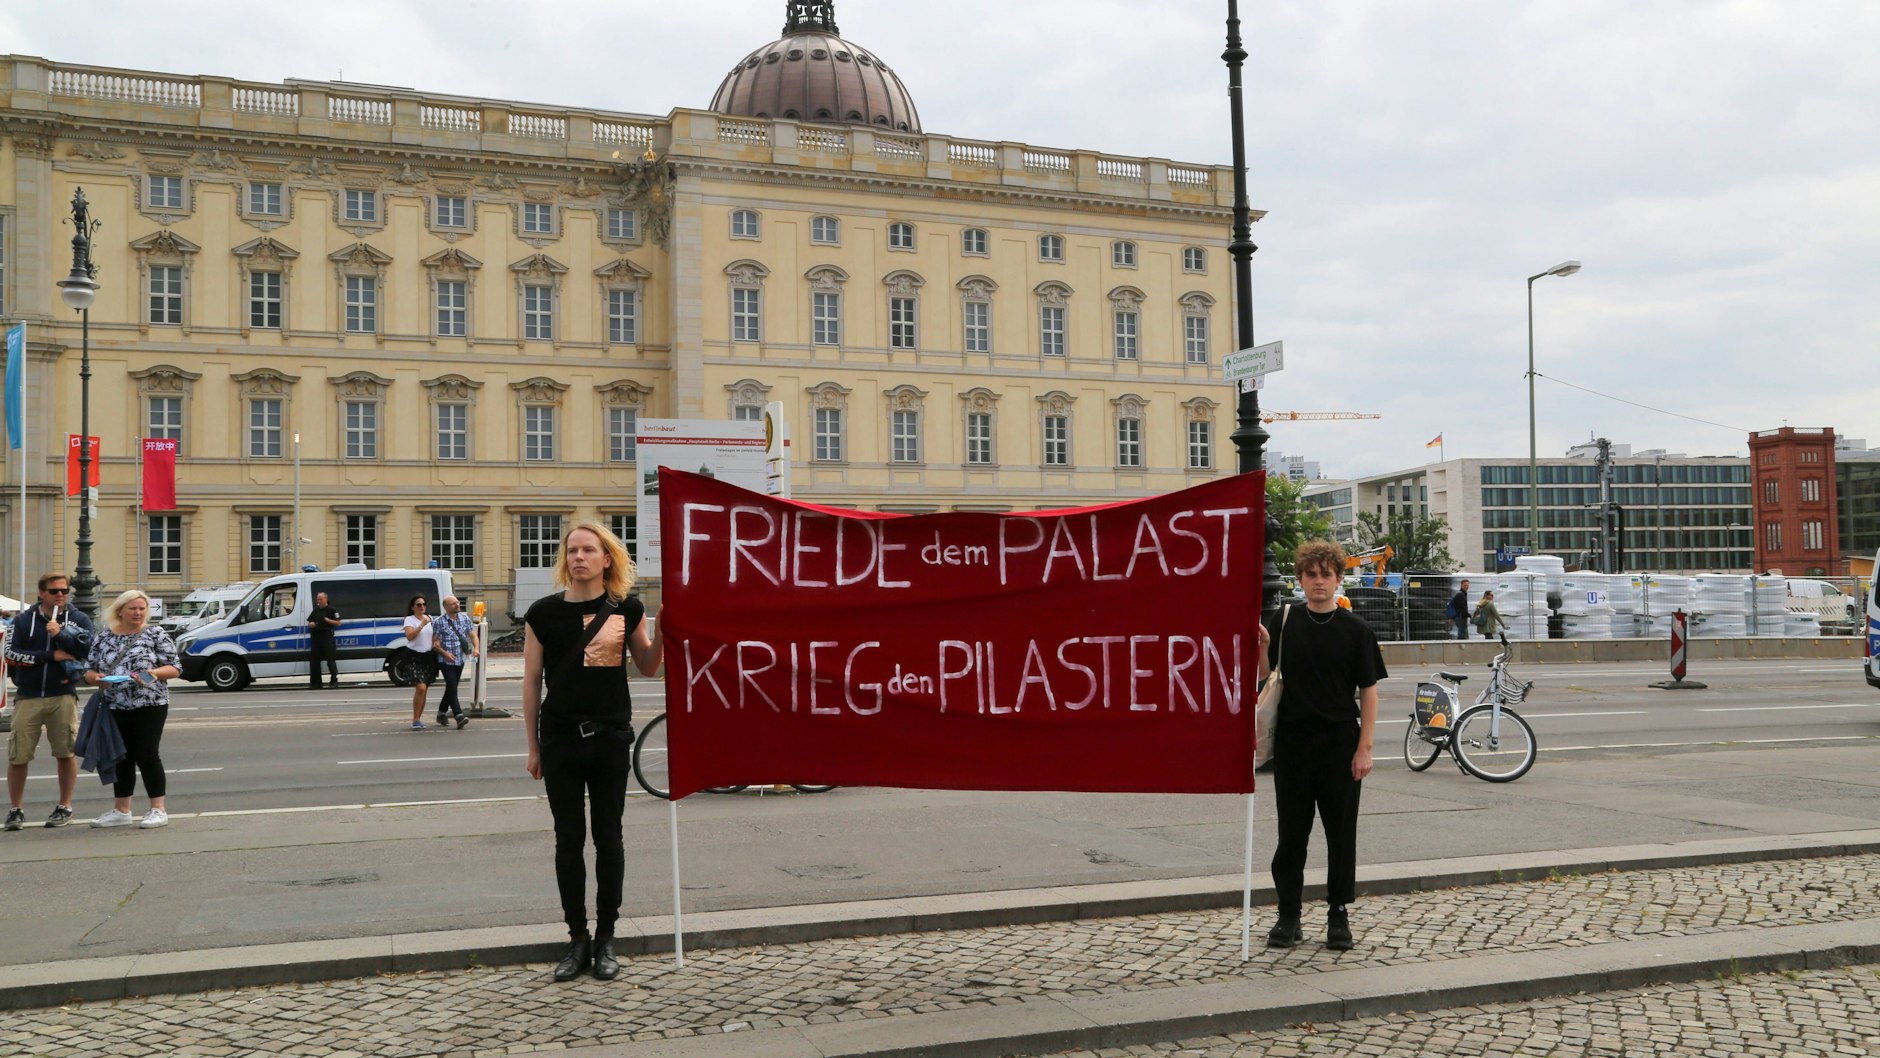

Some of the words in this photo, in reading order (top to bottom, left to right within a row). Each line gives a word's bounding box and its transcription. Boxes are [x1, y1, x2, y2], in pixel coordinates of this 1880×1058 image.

[1233, 351, 1266, 365] Charlottenburg
[145, 441, 175, 451] 开放中
[682, 502, 911, 588] FRIEDE
[921, 529, 989, 566] dem
[999, 507, 1249, 585] PALAST
[1588, 592, 1597, 604] U
[336, 637, 358, 646] LIZEI
[683, 639, 882, 715] KRIEG
[887, 663, 934, 694] den
[939, 634, 1241, 714] PILASTERN
